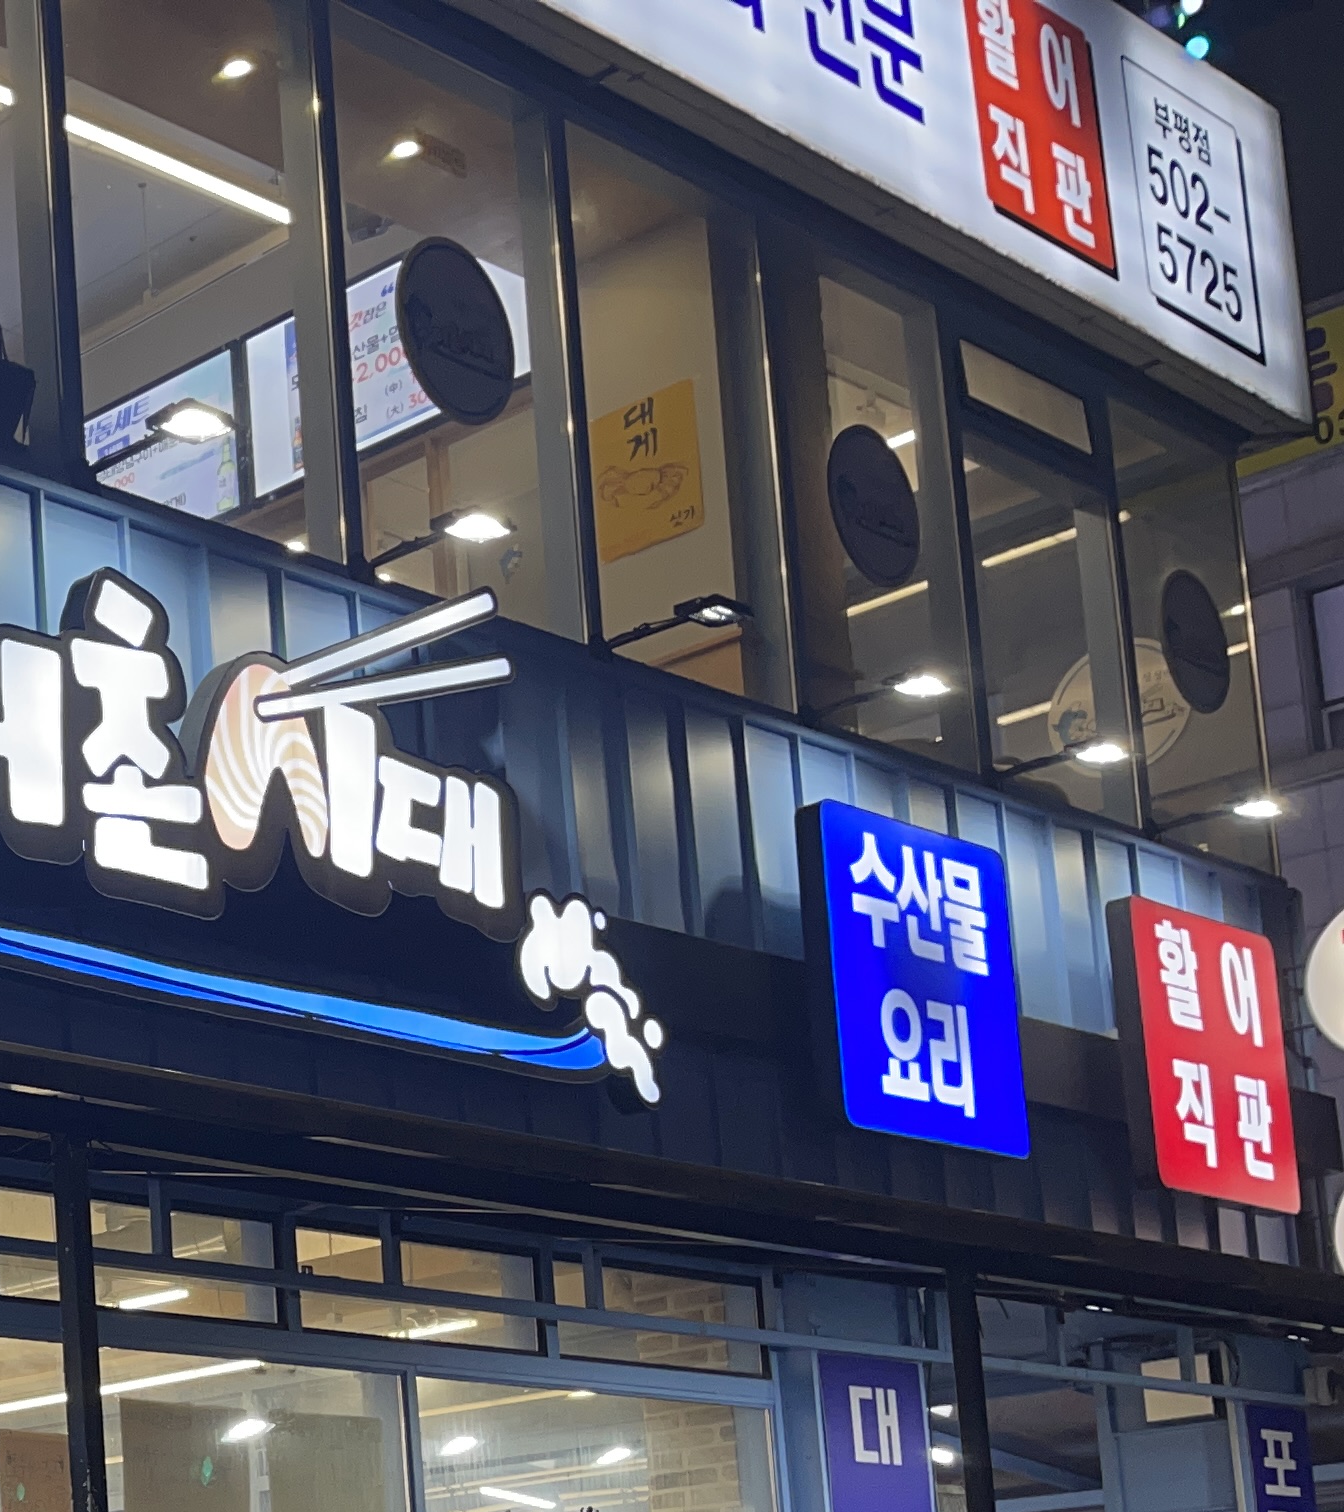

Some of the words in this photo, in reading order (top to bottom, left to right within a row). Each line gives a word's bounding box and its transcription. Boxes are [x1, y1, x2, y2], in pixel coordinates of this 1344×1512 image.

[1152, 96, 1212, 168] 부평점
[1146, 143, 1232, 236] 502-
[1155, 221, 1243, 323] 5725
[848, 830, 991, 977] 수산물
[880, 988, 977, 1119] 요리
